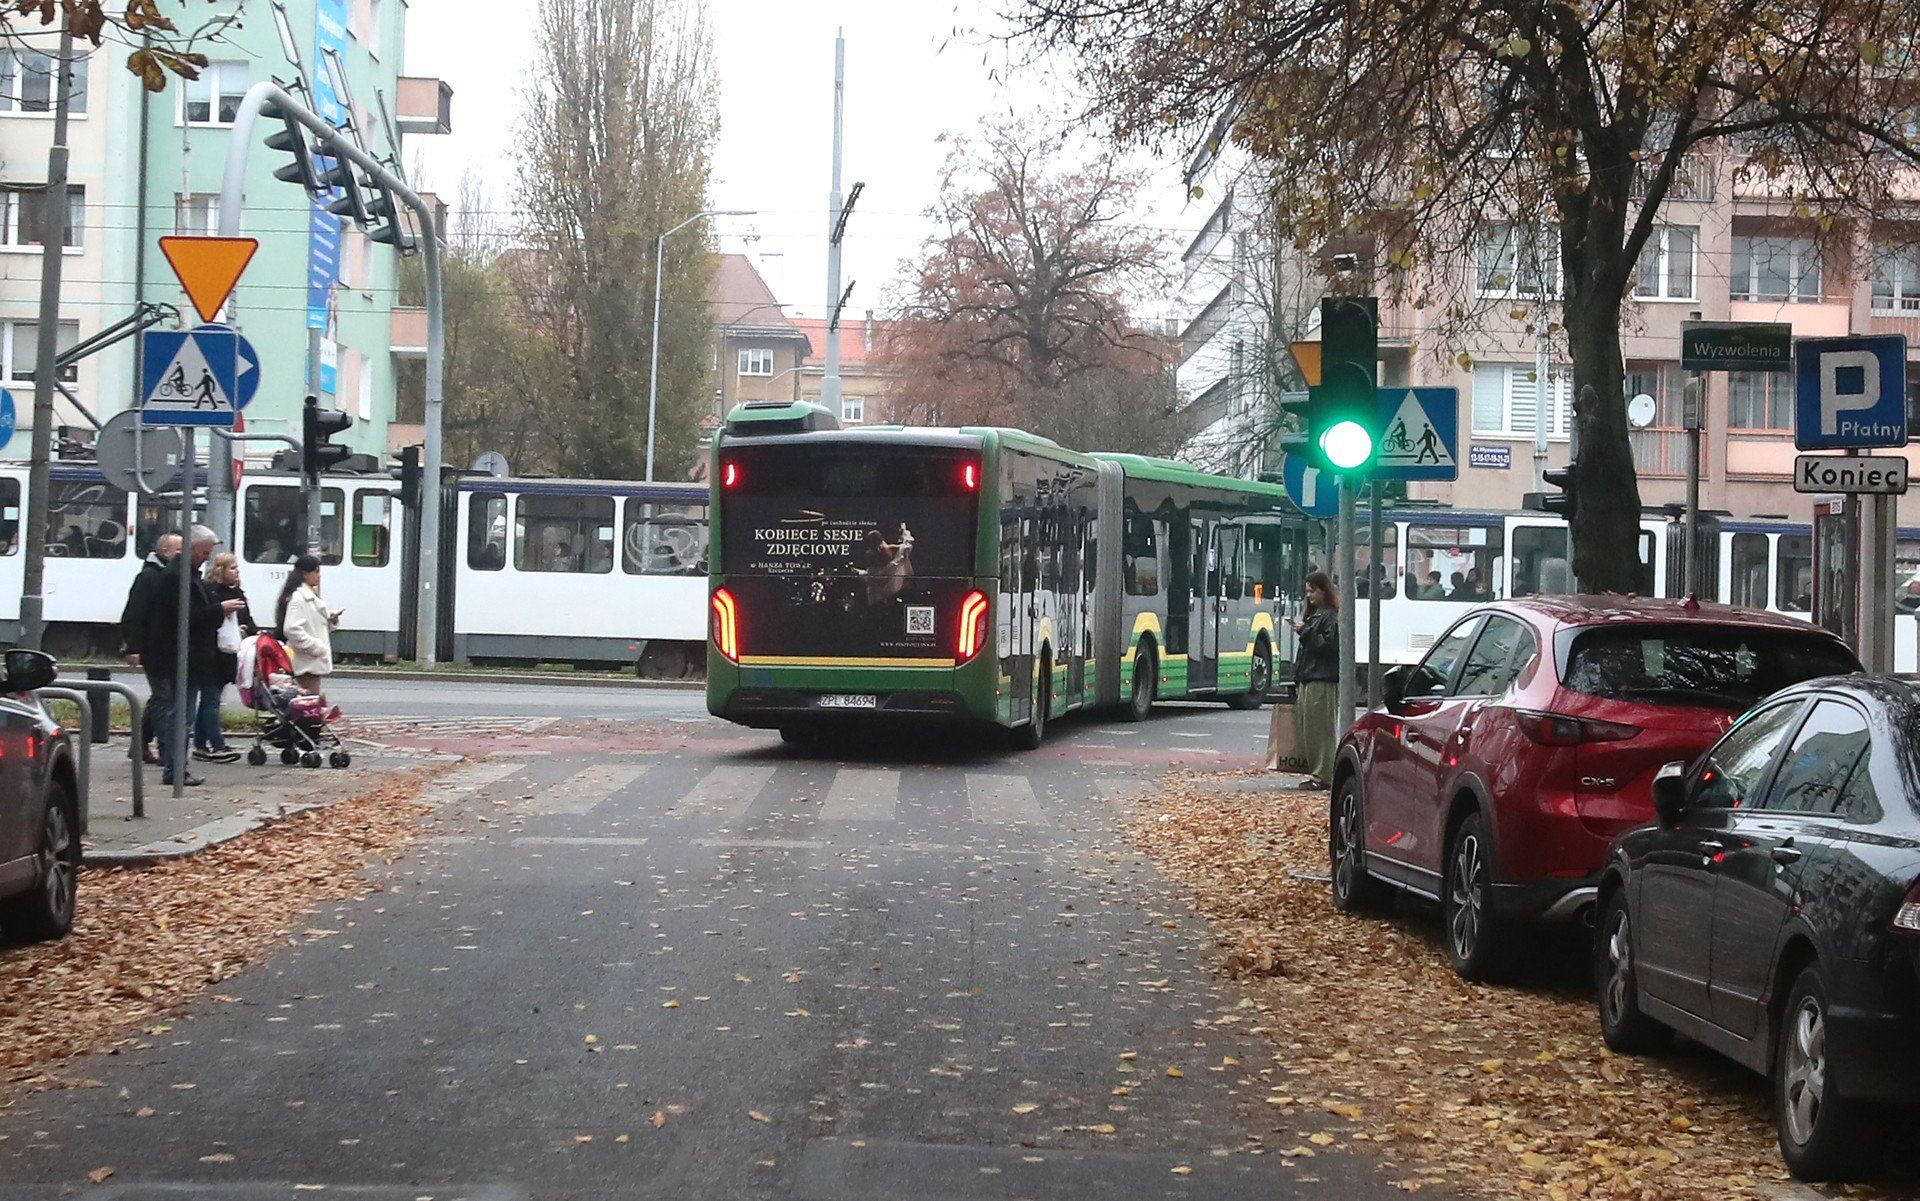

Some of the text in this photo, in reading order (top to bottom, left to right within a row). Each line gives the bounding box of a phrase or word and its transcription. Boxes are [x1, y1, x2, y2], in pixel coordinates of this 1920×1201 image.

[1694, 342, 1781, 358] Wyzwolenia
[1820, 350, 1881, 435] P
[1841, 421, 1901, 440] Płatny
[1803, 461, 1899, 486] Koniec
[754, 528, 864, 541] KOBIECE SESJE
[766, 543, 850, 557] ZDJĘCIOWE
[822, 695, 875, 706] ZPL 84694
[1581, 776, 1615, 787] CX-5
